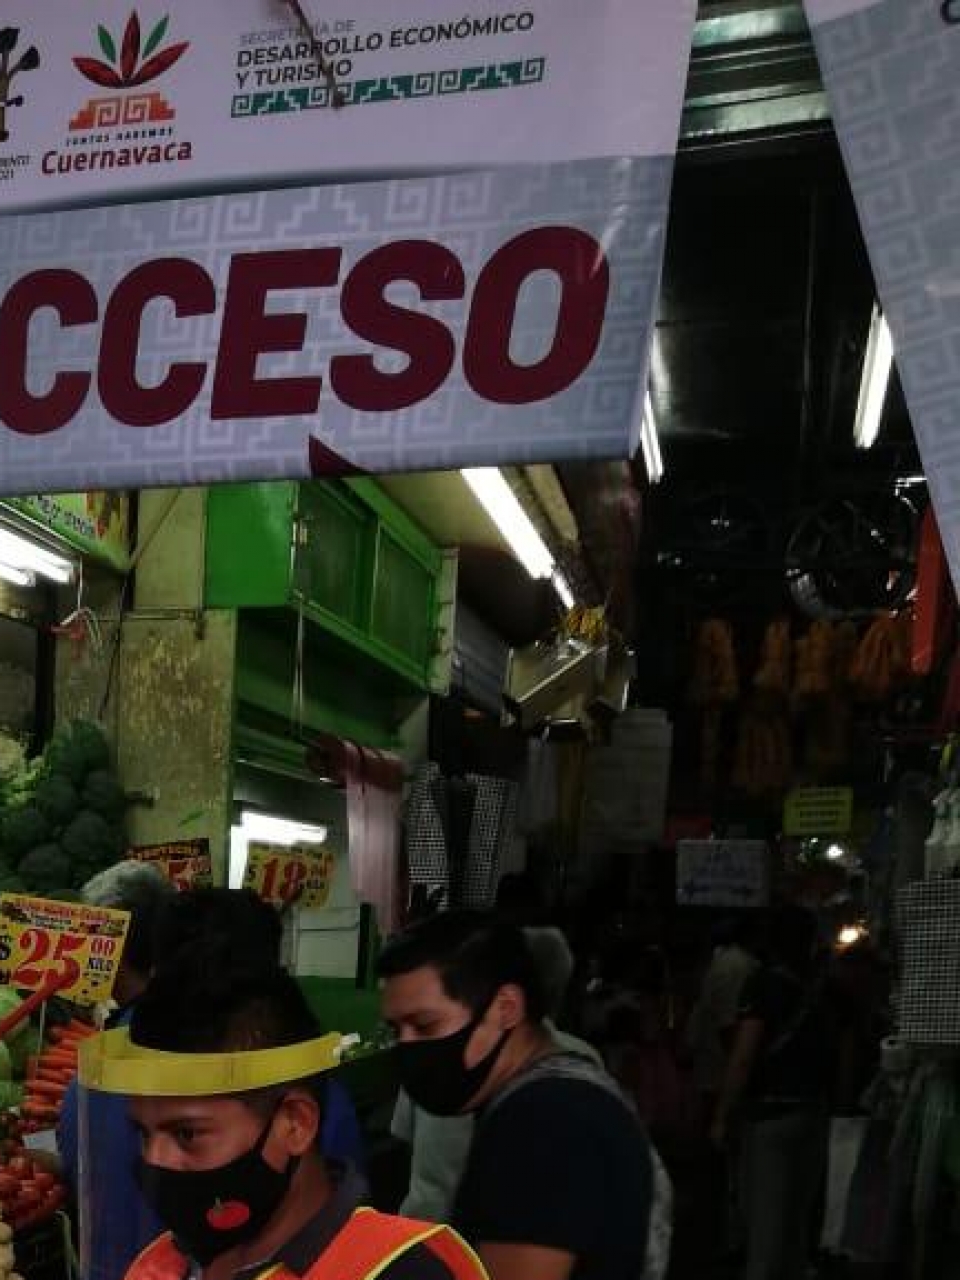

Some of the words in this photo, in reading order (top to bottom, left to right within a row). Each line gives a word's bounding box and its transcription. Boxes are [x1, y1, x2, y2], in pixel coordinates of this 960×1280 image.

[236, 32, 383, 68] DESARROLLO
[389, 12, 535, 48] ECONÓMICO
[236, 71, 249, 89] Y
[255, 59, 352, 86] TURISMO
[41, 142, 193, 176] Cuernavaca
